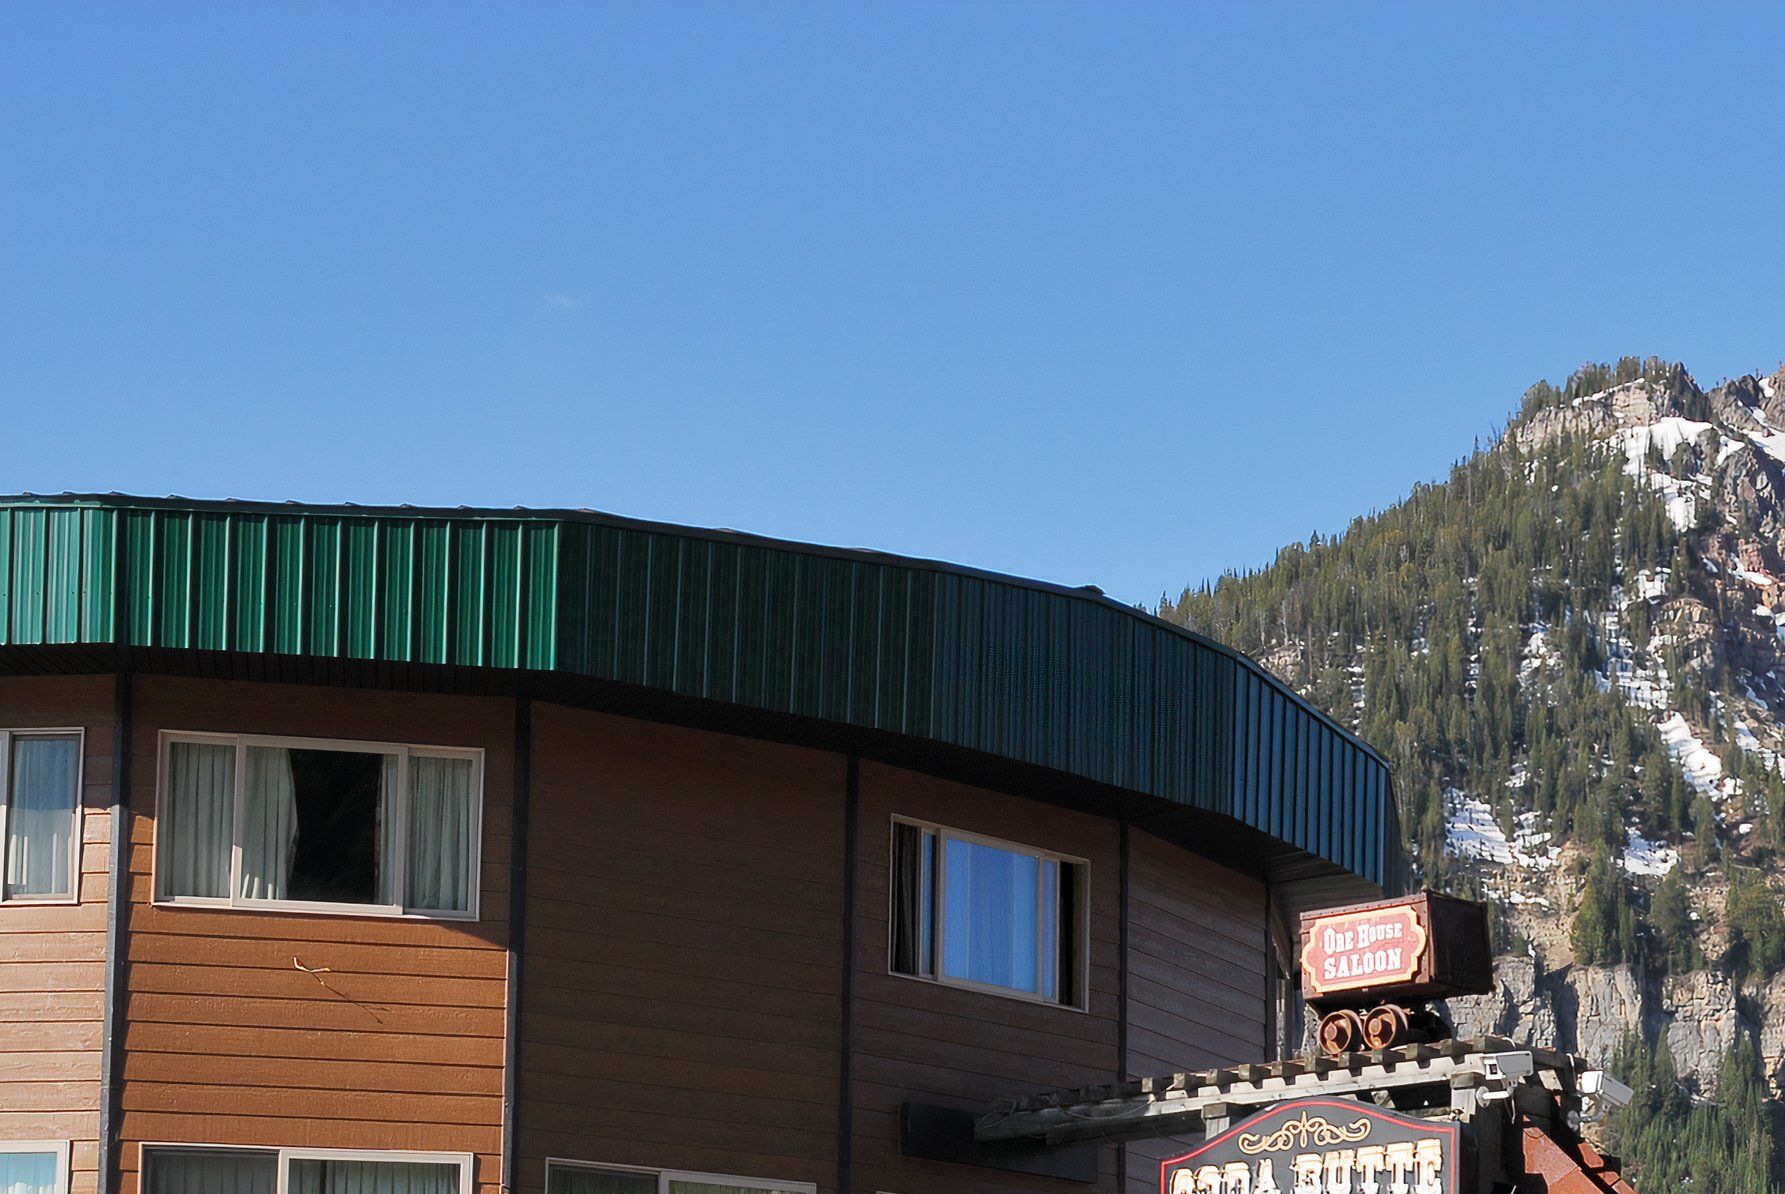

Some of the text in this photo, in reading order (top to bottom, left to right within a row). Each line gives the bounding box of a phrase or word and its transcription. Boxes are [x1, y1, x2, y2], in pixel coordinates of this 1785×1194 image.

[1324, 922, 1403, 955] ORE HOUSE
[1324, 947, 1402, 980] SALOON
